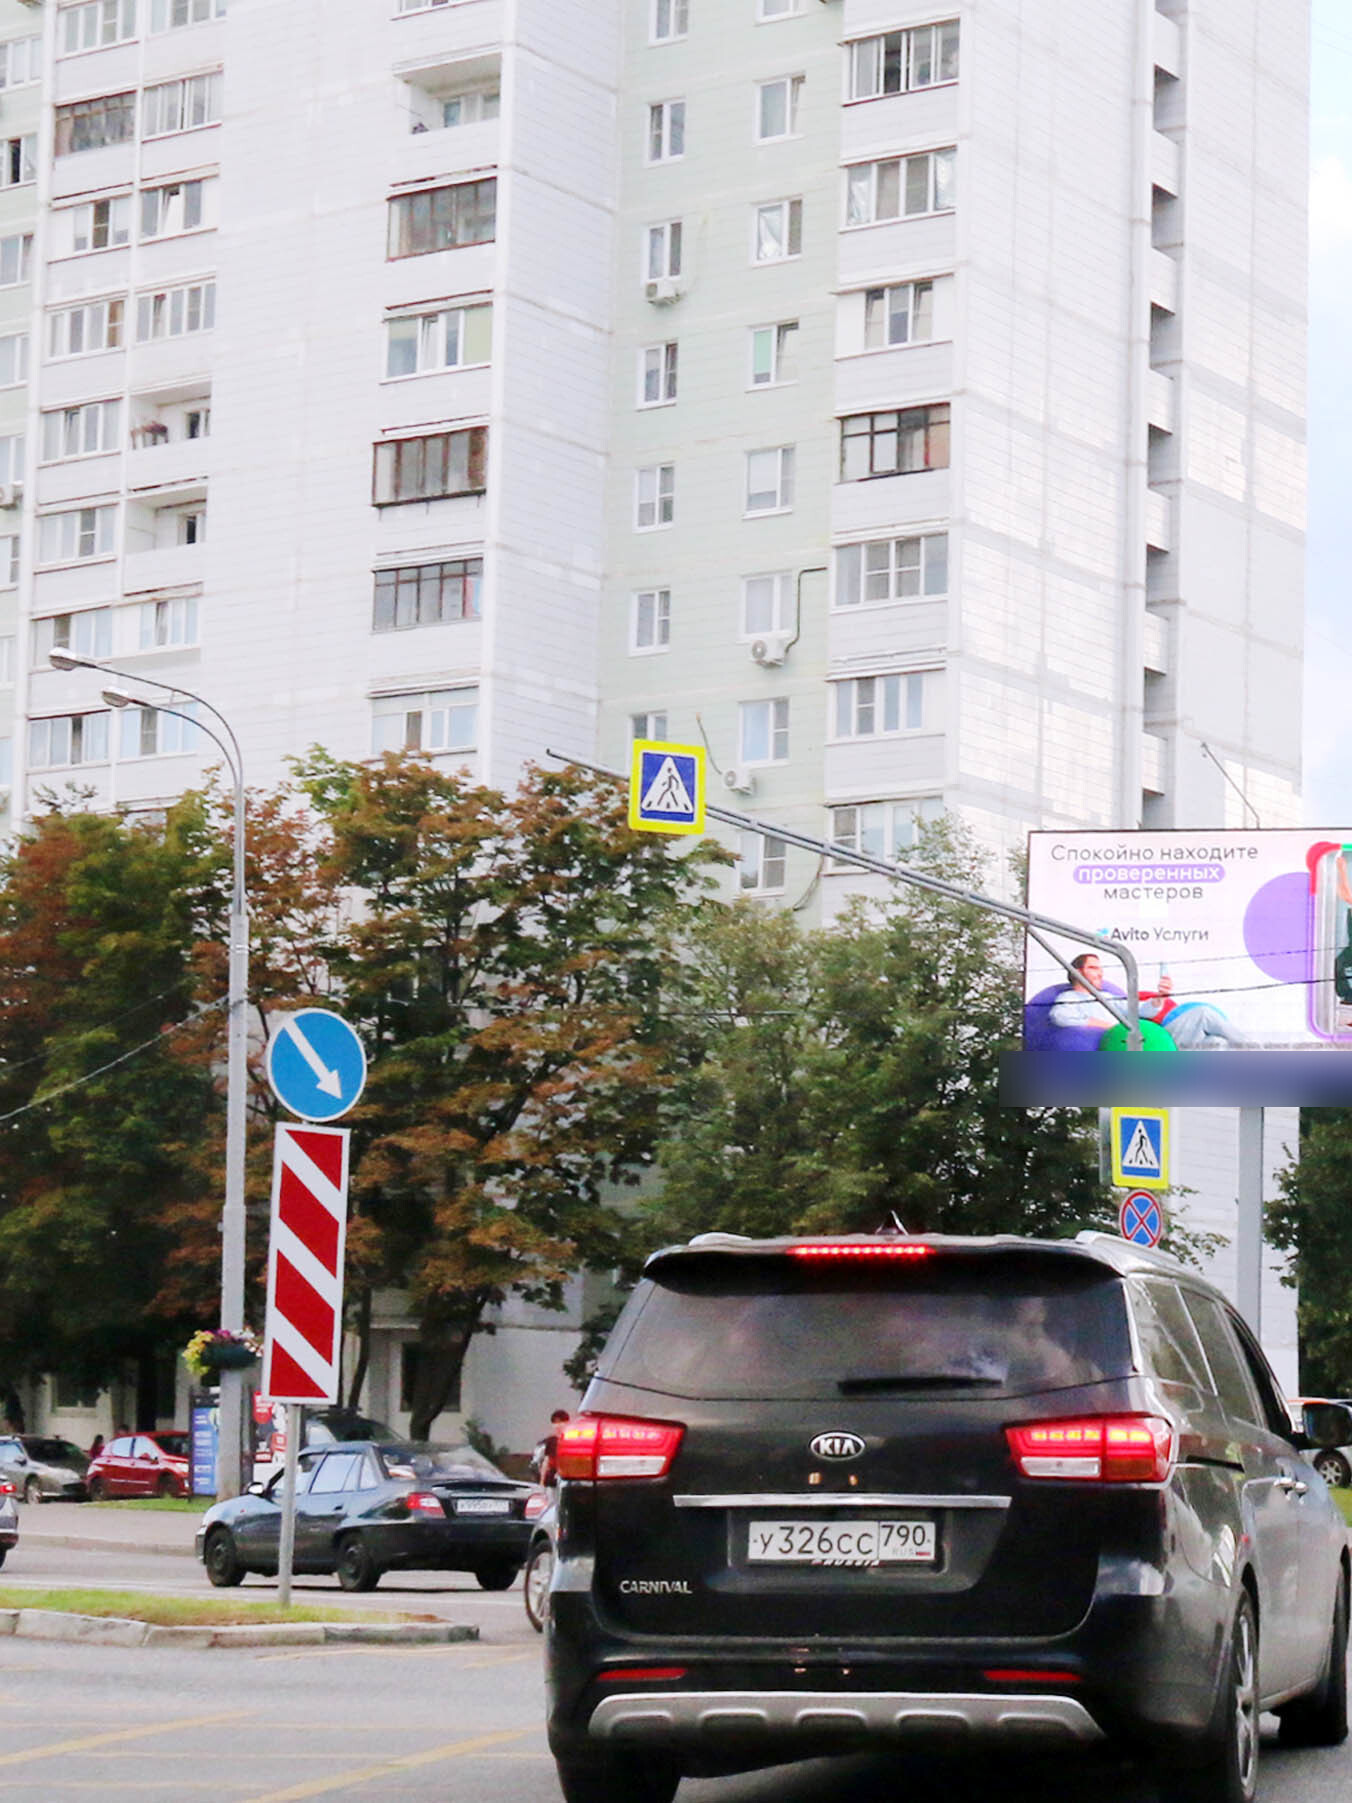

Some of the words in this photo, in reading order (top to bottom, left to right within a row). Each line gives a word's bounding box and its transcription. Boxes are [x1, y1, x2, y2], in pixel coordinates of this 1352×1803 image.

[1051, 844, 1154, 861] Спокойно
[1160, 846, 1258, 861] находите
[1078, 867, 1220, 884] проверенных
[1104, 887, 1203, 902] мастеров
[1111, 928, 1149, 940] Avito
[1153, 928, 1208, 943] Услуги
[819, 1438, 856, 1455] KIA
[881, 1524, 926, 1546] 790
[619, 1580, 693, 1595] CARNIVAL
